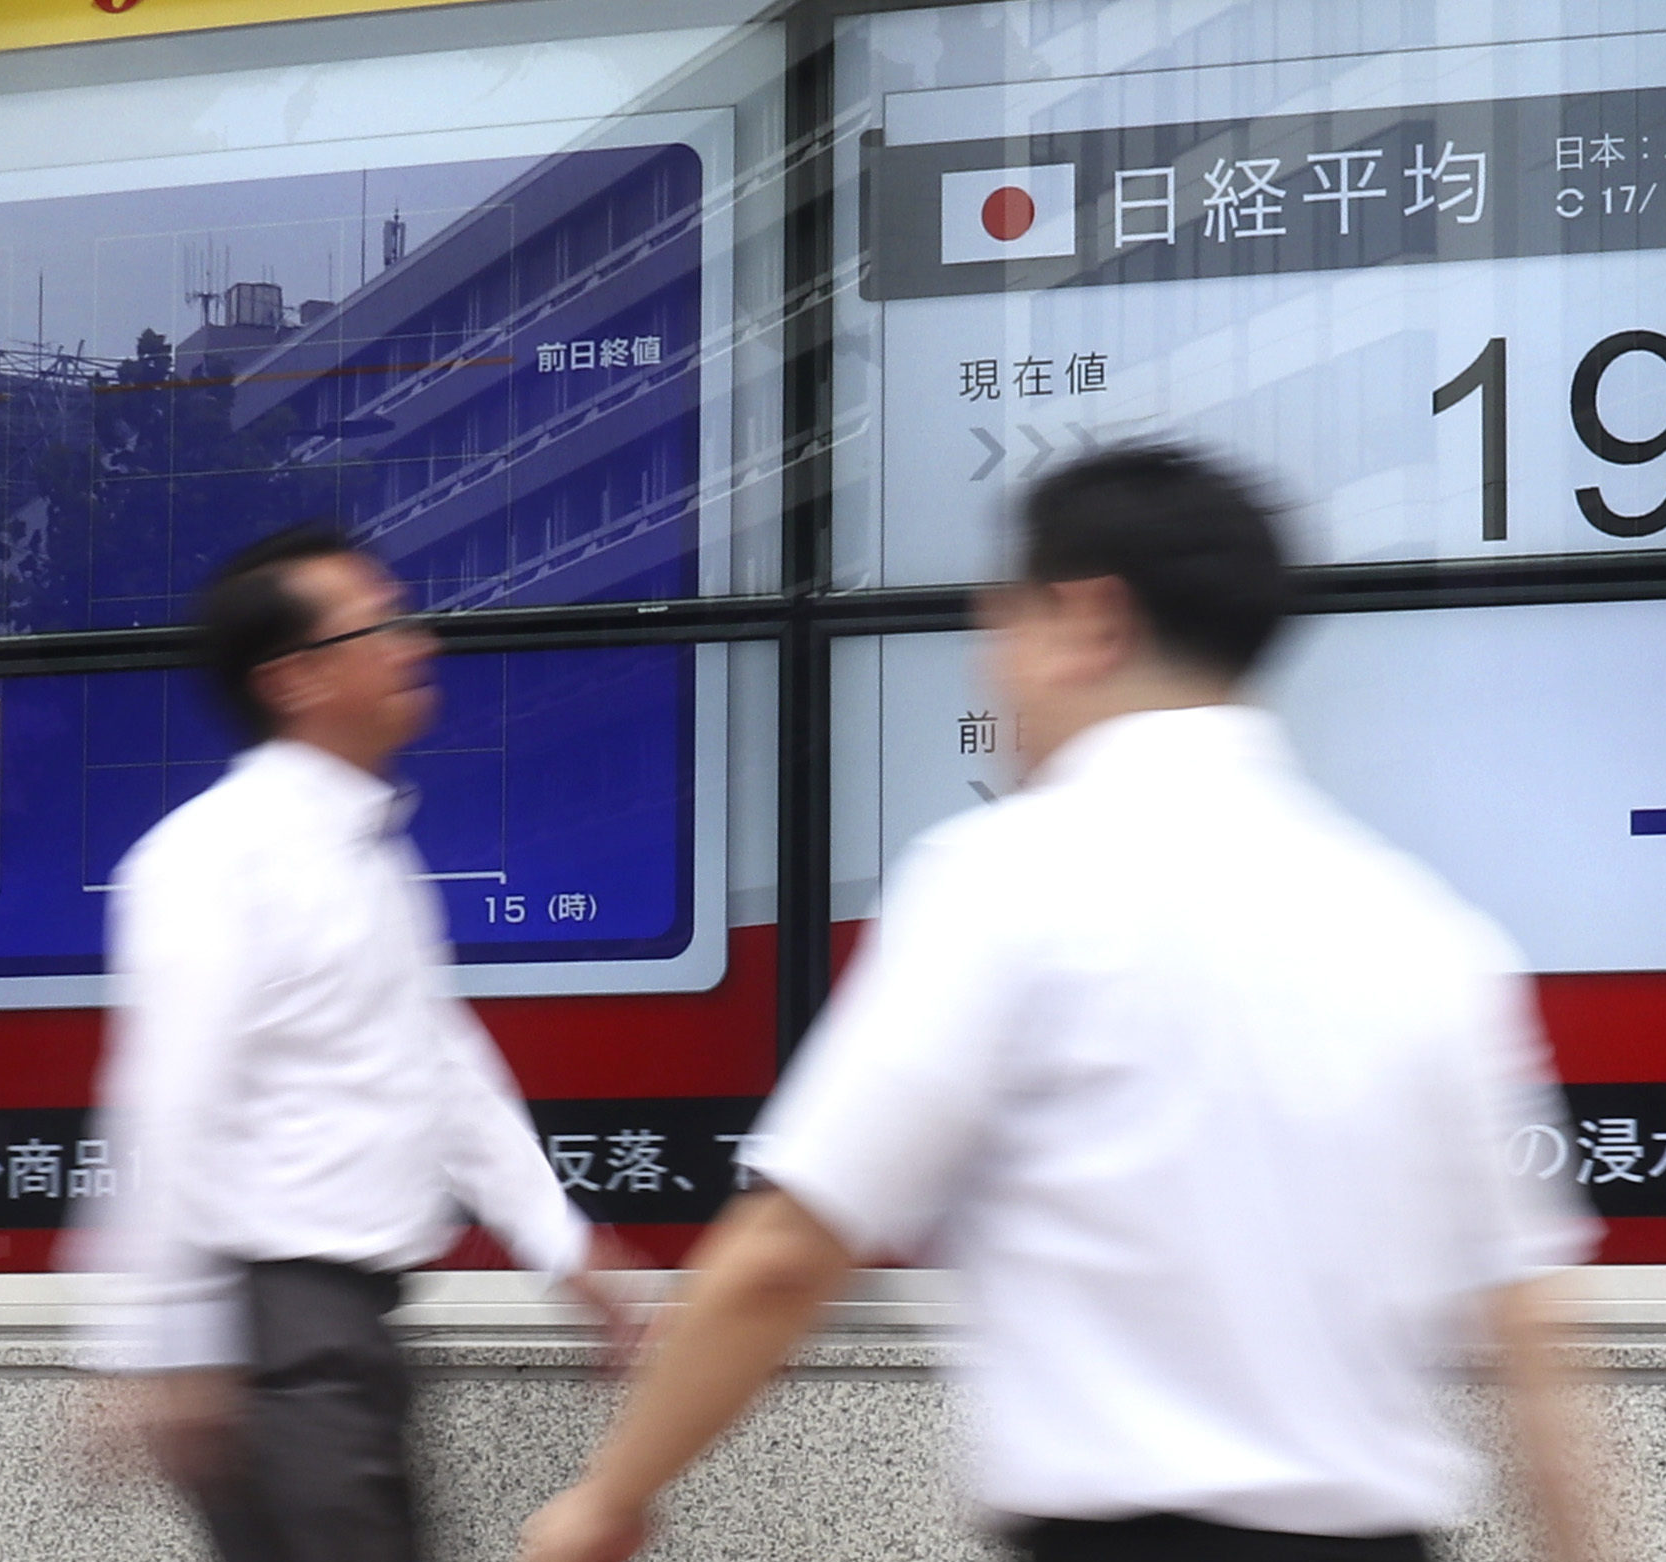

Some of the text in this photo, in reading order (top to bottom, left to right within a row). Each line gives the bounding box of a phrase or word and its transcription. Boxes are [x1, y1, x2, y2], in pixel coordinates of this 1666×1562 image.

[1111, 140, 1488, 249] 日経平均
[536, 336, 662, 374] 前日終値
[959, 350, 1109, 403] 現在値
[484, 895, 526, 924] 15
